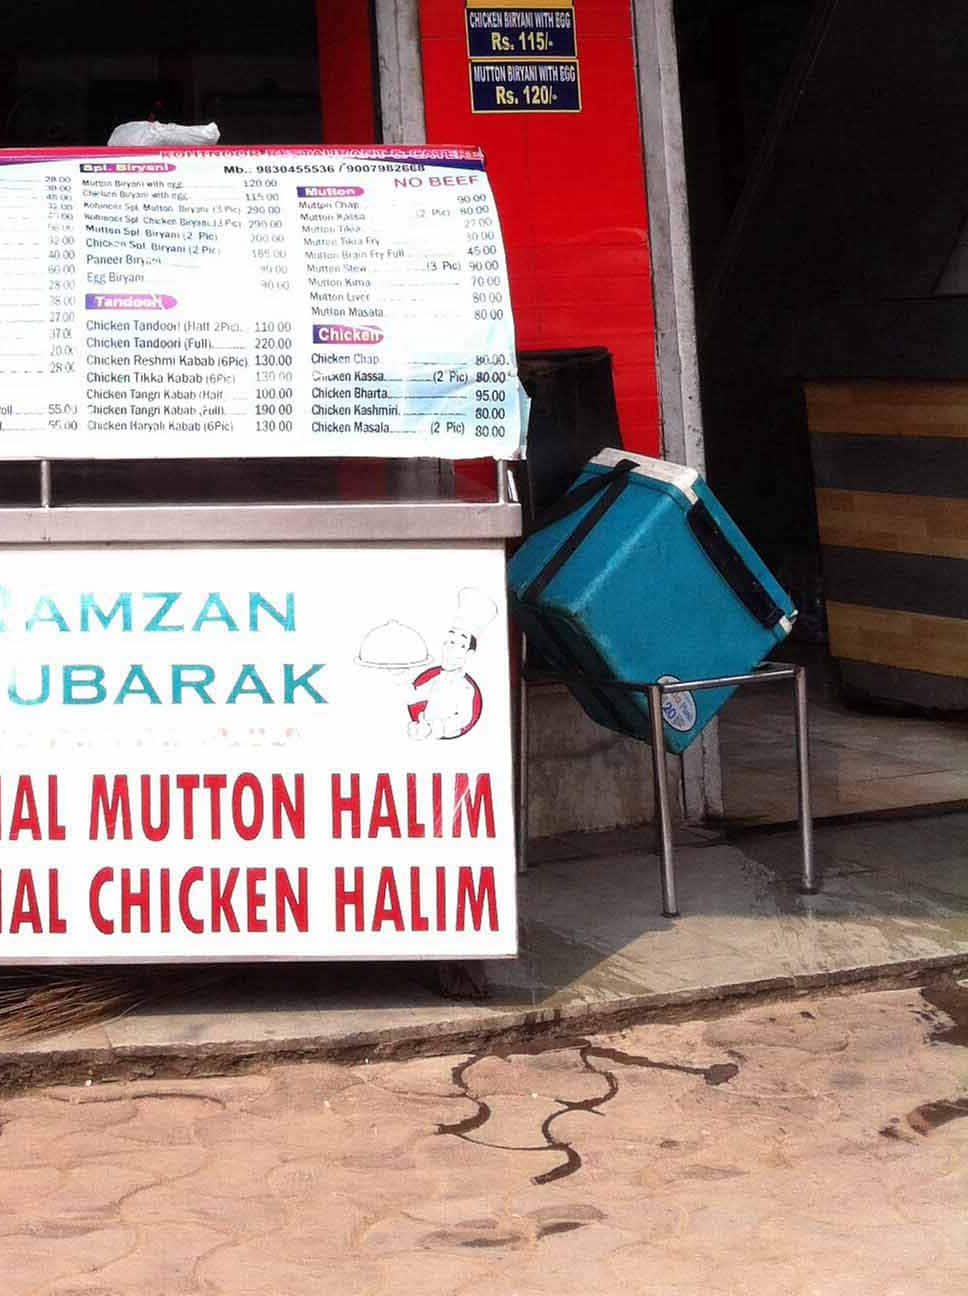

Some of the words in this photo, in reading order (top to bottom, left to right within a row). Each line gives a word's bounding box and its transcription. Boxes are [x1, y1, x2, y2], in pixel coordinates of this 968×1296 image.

[470, 12, 502, 28] CHICKEN
[504, 12, 532, 28] BIRYANI
[536, 12, 553, 28] WITH
[556, 12, 571, 28] EGG
[492, 32, 515, 51] Rs.
[519, 32, 553, 50] 115/-
[474, 66, 506, 82] MUTTON
[508, 66, 537, 82] BIRYANI
[539, 66, 559, 82] WITH
[560, 66, 575, 82] EGG
[496, 86, 518, 104] Rs.
[523, 85, 557, 104] 120/-
[116, 163, 169, 173] Biryani
[256, 165, 334, 173] 9830455536
[394, 176, 423, 188] NO
[429, 175, 480, 187] BEEF
[305, 188, 355, 196] Mutton
[86, 319, 130, 332] Chicken
[133, 319, 180, 332] Tandoori
[254, 321, 291, 333] 110.00
[318, 326, 379, 341] Chicken
[86, 336, 130, 349] Chicken
[133, 336, 181, 349] Tandoori
[254, 337, 292, 350] 220.00
[86, 354, 130, 366] Chicken
[134, 354, 176, 366] Reshmi
[179, 354, 215, 367] Kabab
[217, 356, 248, 369] (6Pic)
[255, 354, 292, 367] 130.00
[311, 352, 351, 364] Chicken
[353, 352, 379, 366] Chap
[86, 371, 130, 383] Chicken
[134, 371, 164, 383] Tikka
[167, 371, 203, 384] Kabab
[312, 370, 351, 382] Chicken
[354, 370, 384, 382] Kassa
[449, 371, 468, 384] Pic)
[475, 371, 506, 384] 80.00
[86, 388, 127, 400] Chicken
[163, 388, 196, 401] Kabab
[255, 387, 292, 400] 100.00
[312, 387, 351, 399] Chicken
[354, 387, 388, 399] Bharta
[475, 390, 506, 402] 95.00
[87, 403, 127, 416] Chicken
[163, 404, 197, 416] Kabab
[255, 403, 292, 416] 190.00
[312, 404, 351, 416] Chicken
[354, 404, 398, 416] Kashmiri
[87, 420, 127, 432] Chicken
[168, 421, 201, 432] Kabab
[255, 420, 292, 433] 130.00
[312, 421, 351, 433] Chicken
[354, 421, 390, 433] Masala
[446, 422, 464, 435] Pic)
[88, 771, 305, 842] MUTTON
[333, 772, 497, 839] HALIM
[89, 865, 308, 935] CHICKEN
[335, 865, 500, 933] HALIM
